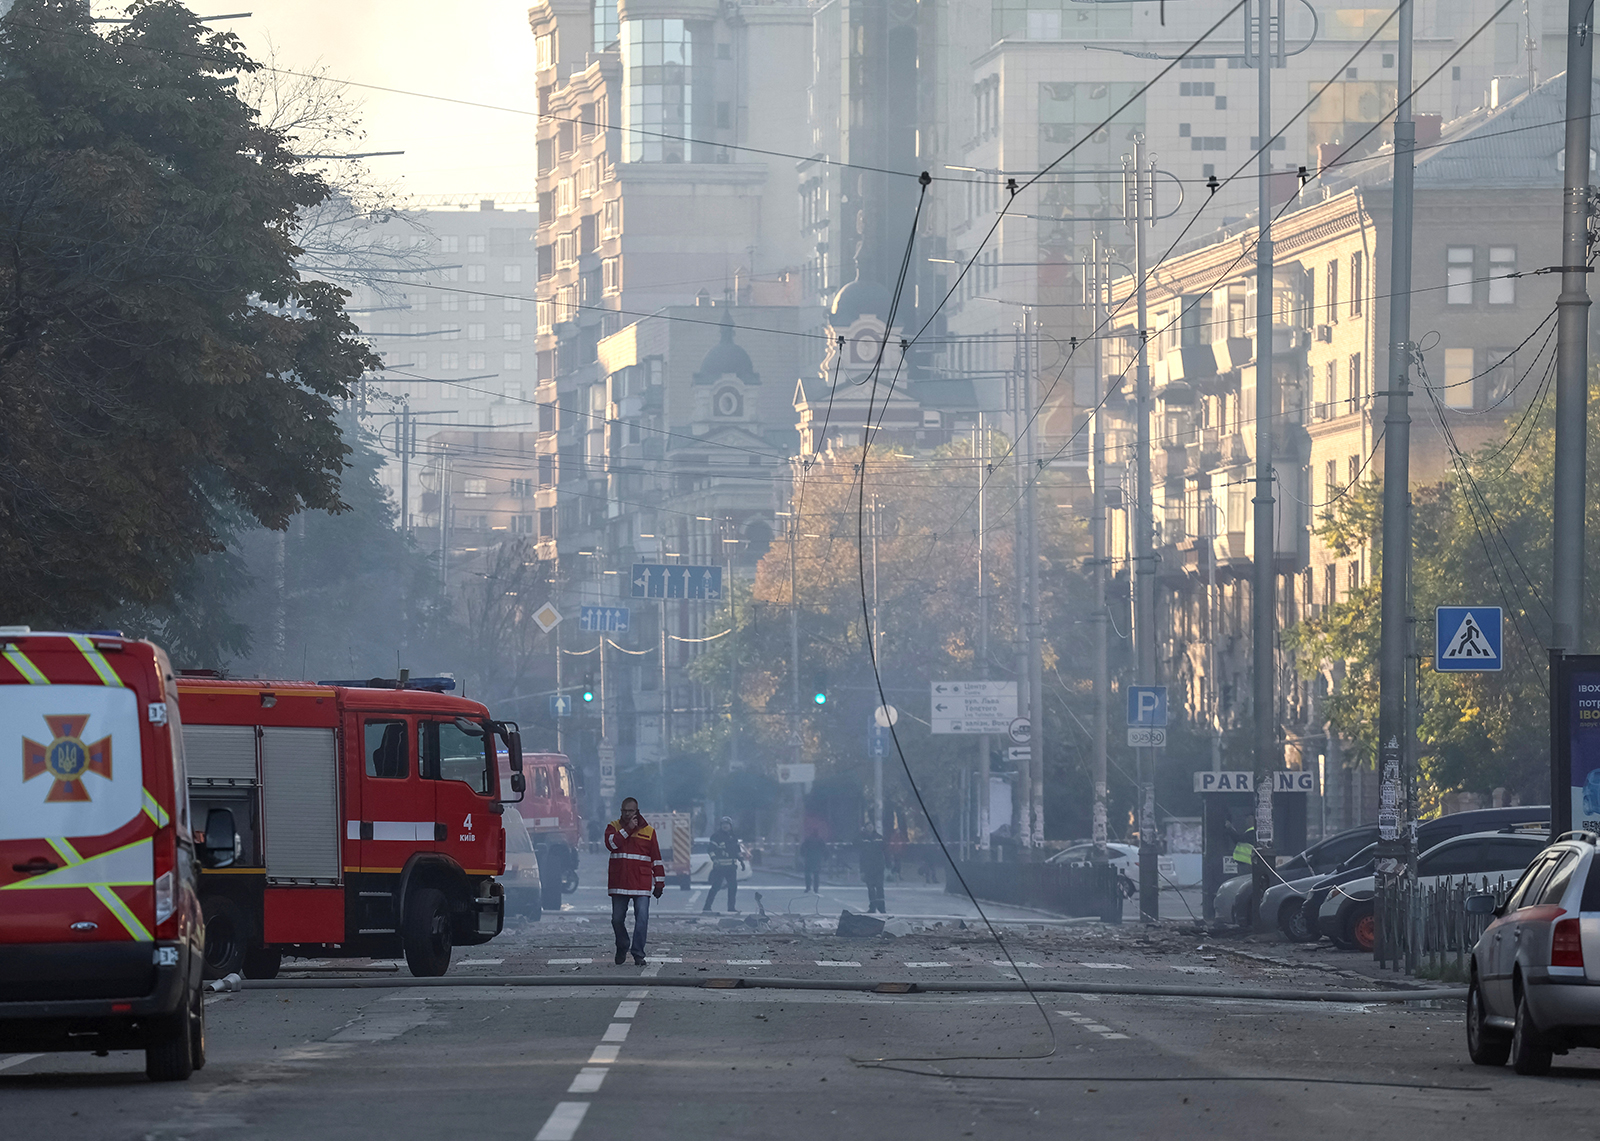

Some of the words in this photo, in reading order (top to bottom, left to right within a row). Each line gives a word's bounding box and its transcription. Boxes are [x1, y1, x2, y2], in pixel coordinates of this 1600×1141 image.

[1137, 691, 1160, 722] P
[1202, 774, 1312, 790] PARNG
[462, 813, 473, 831] 4
[648, 821, 667, 830] 01
